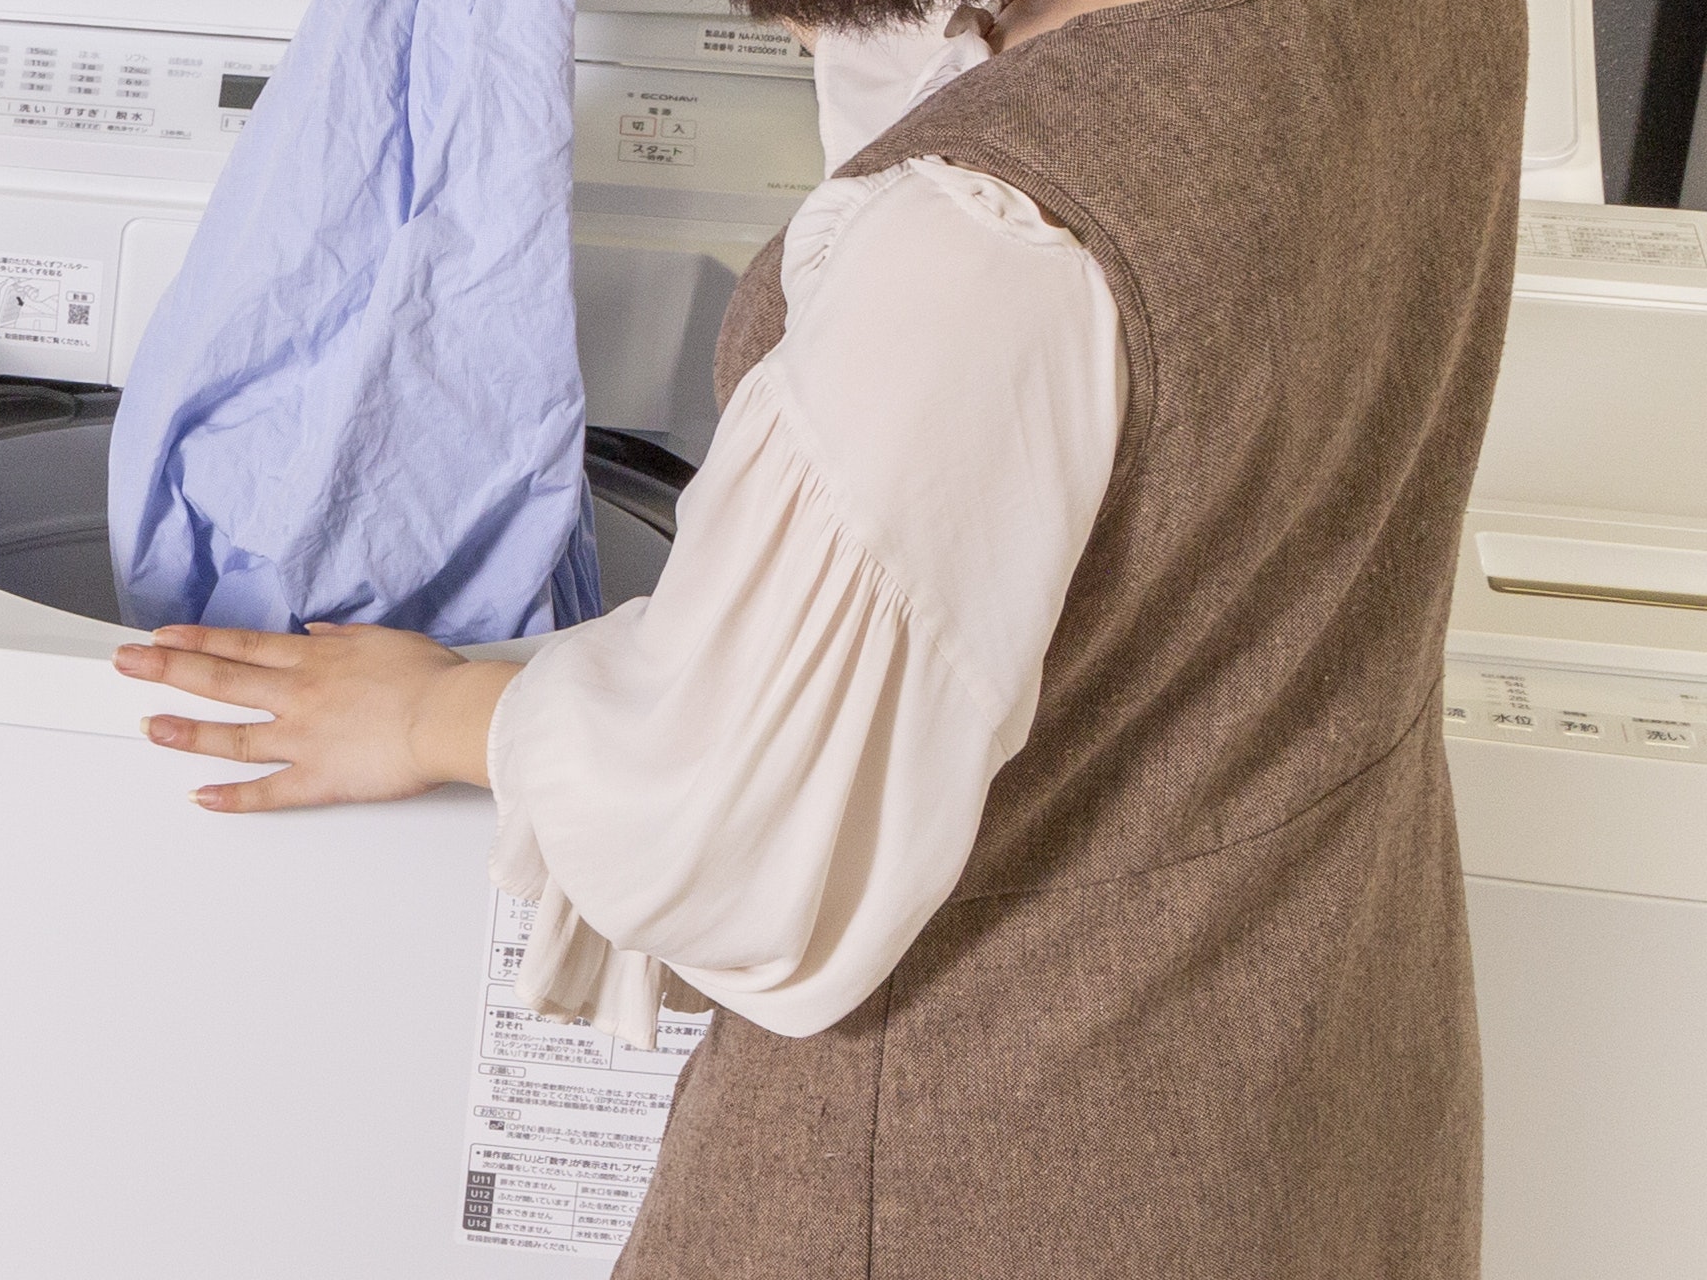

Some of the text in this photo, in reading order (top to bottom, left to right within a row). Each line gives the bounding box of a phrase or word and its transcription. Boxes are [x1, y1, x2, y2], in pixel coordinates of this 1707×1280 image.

[640, 93, 698, 103] ECONAVI
[19, 104, 46, 113] 洗い
[63, 107, 99, 118] すすぎ
[115, 110, 143, 121] 脱水
[632, 121, 645, 132] 切
[672, 123, 685, 135] 入
[633, 143, 682, 157] スタート
[1492, 713, 1533, 726] 水位
[1560, 720, 1599, 734] 予約
[1645, 729, 1686, 741] 洗い
[495, 1020, 524, 1032] おそれ
[489, 1065, 516, 1076] お願い
[480, 1107, 515, 1118] お知らせ
[472, 1175, 492, 1185] U11
[500, 1178, 557, 1191] 排水できません
[470, 1189, 490, 1199] U12
[498, 1193, 571, 1207] ふたが開いています
[469, 1204, 489, 1214] U13
[497, 1207, 553, 1220] 脱水できません
[467, 1219, 487, 1229] U14
[495, 1222, 552, 1235] 給水できません
